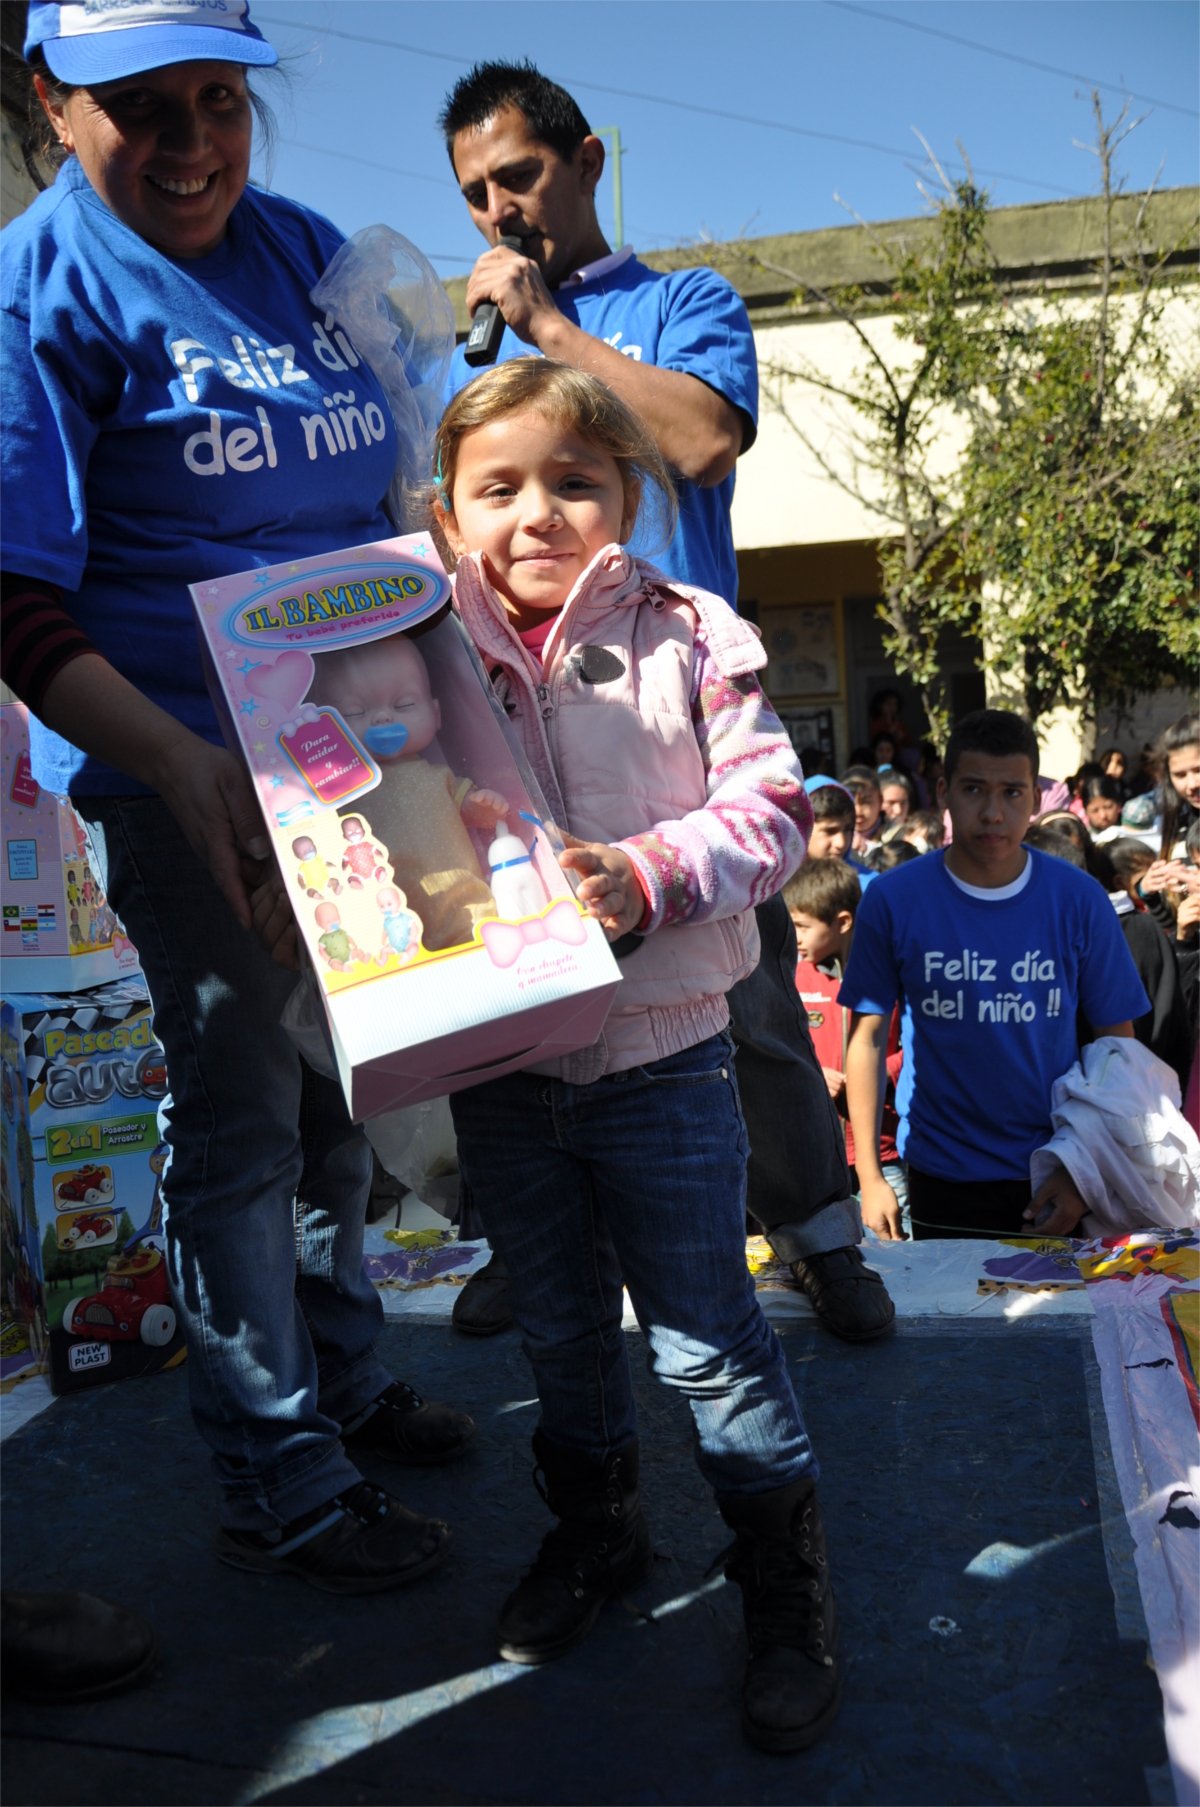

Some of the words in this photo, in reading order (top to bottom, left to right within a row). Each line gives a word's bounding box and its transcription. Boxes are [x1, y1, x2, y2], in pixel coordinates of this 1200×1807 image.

[170, 334, 310, 403] Feliz
[312, 310, 360, 372] dí
[183, 405, 278, 476] del
[300, 389, 386, 461] niño
[244, 606, 282, 633] IL
[278, 573, 426, 627] BAMBINO
[340, 610, 400, 631] preferido
[301, 734, 331, 753] Para
[307, 742, 339, 764] cuidar
[924, 949, 997, 983] Feliz
[1011, 950, 1056, 982] día
[921, 989, 964, 1021] del
[978, 993, 1036, 1023] niño
[1046, 987, 1061, 1018] !!
[107, 1132, 143, 1145] Arrastre
[74, 1352, 106, 1367] PLAST
[77, 1343, 103, 1357] NEW
